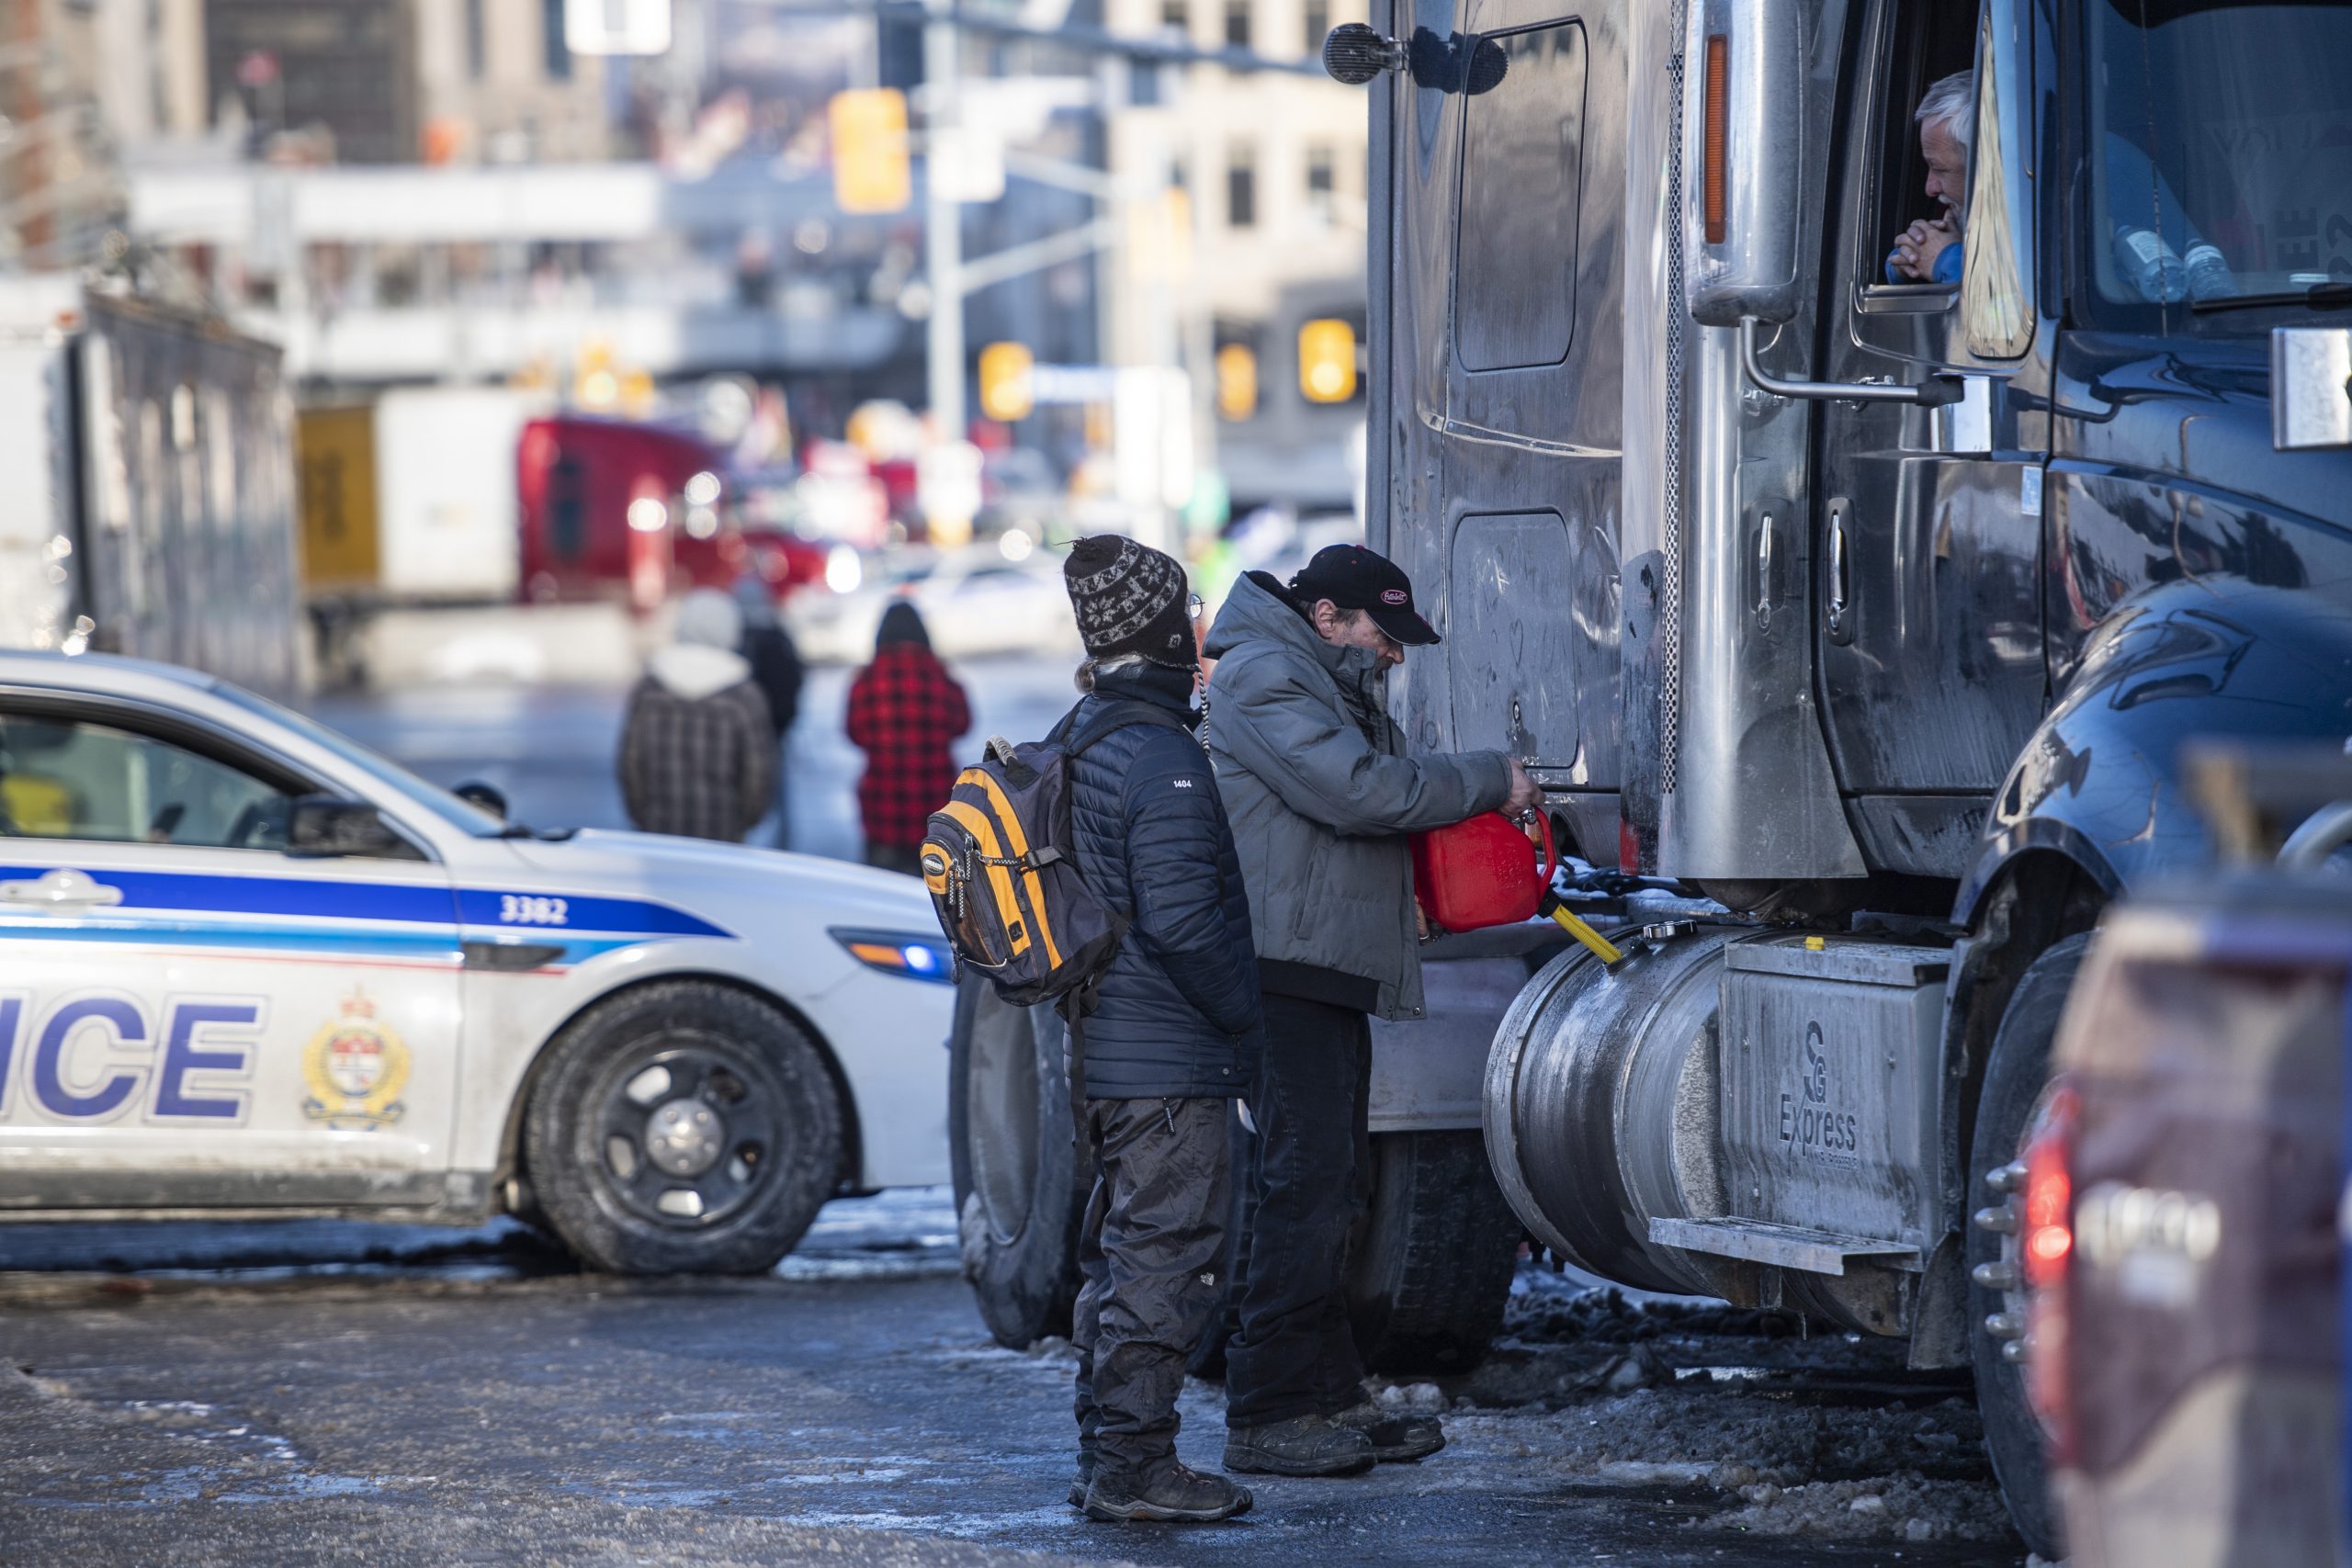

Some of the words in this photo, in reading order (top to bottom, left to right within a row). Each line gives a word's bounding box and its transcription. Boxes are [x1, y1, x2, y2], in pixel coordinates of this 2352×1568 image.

[1173, 780, 1192, 788] 1404
[499, 895, 569, 925] 3382
[1780, 1093, 1856, 1176] Express
